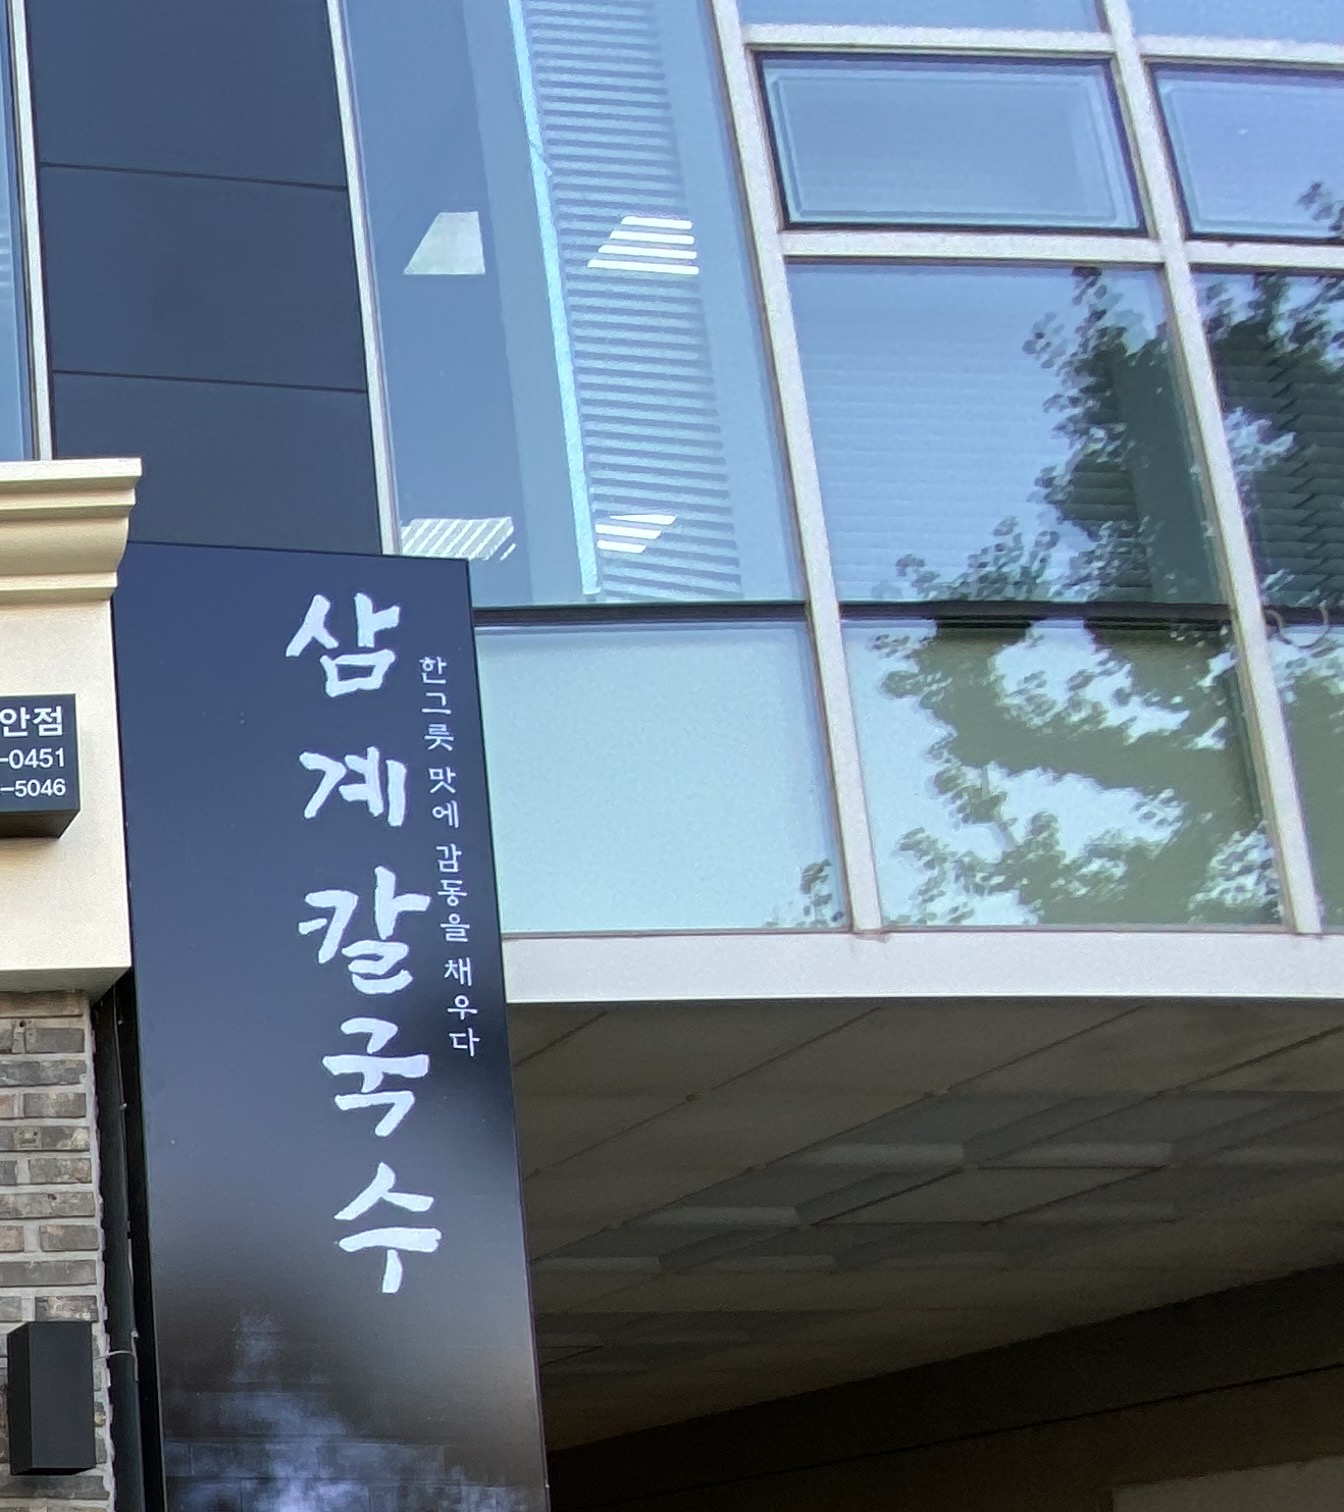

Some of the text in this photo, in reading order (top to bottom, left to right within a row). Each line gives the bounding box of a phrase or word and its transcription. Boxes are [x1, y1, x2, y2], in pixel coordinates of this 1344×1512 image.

[427, 766, 460, 829] 맛에
[435, 843, 471, 943] 감동을
[443, 957, 481, 1058] 채우다
